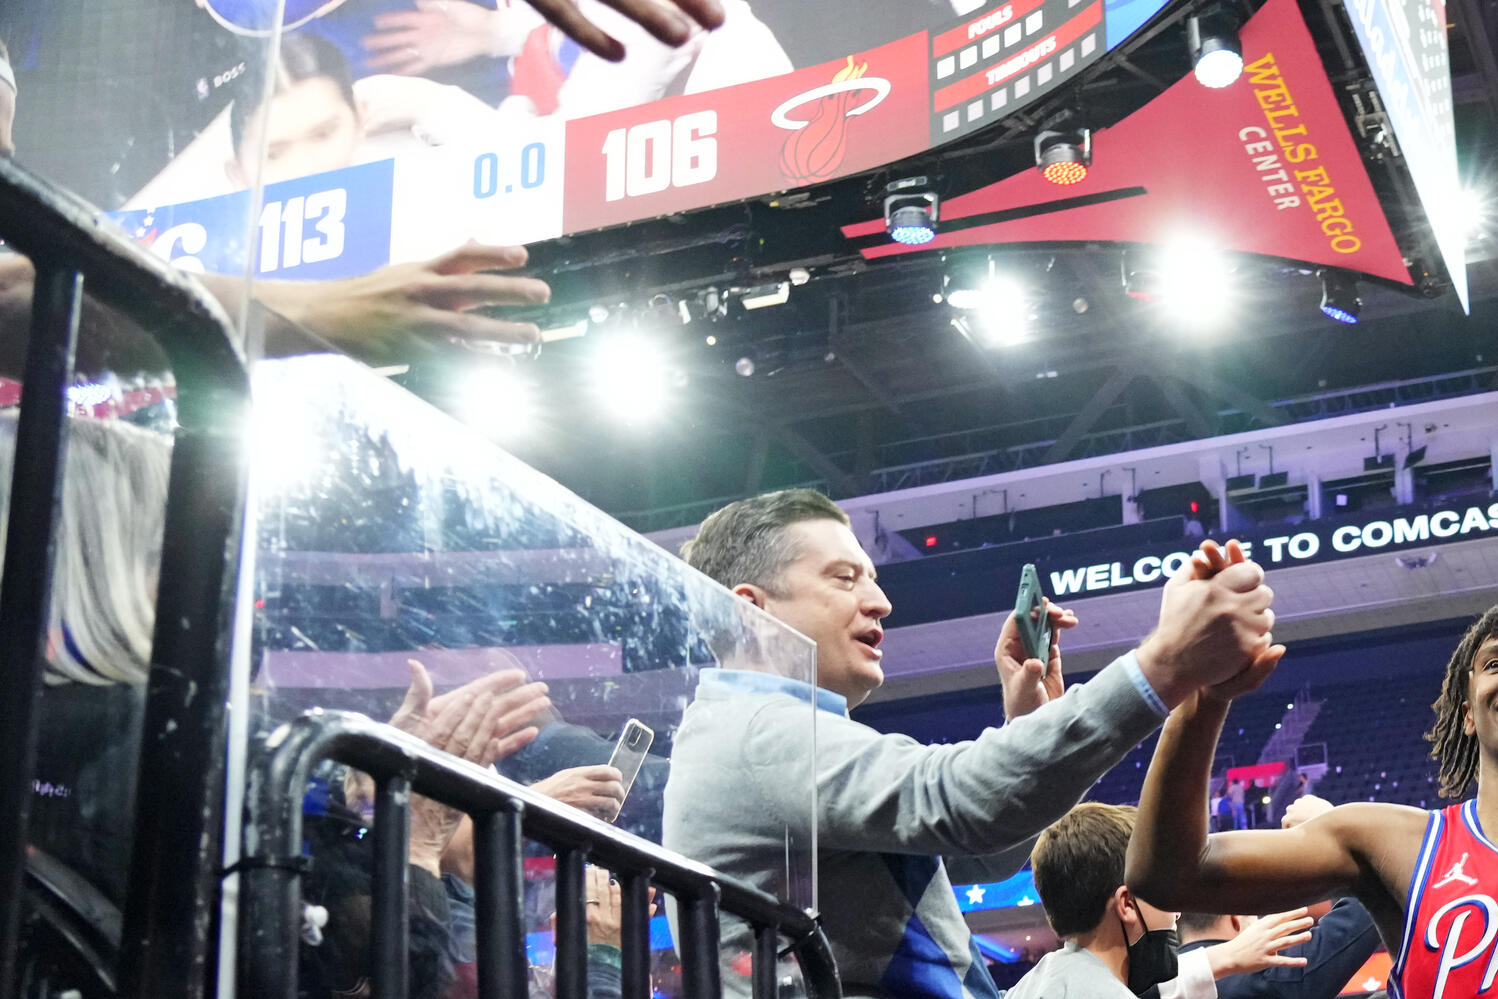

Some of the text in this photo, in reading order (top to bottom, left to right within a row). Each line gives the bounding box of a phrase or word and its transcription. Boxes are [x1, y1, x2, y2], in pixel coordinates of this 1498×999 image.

[473, 142, 546, 199] 0.0
[601, 109, 717, 203] 106
[1239, 125, 1300, 210] CENTER
[1244, 52, 1361, 254] WELLS FARGO
[258, 188, 347, 273] 113
[1264, 532, 1320, 563] TO
